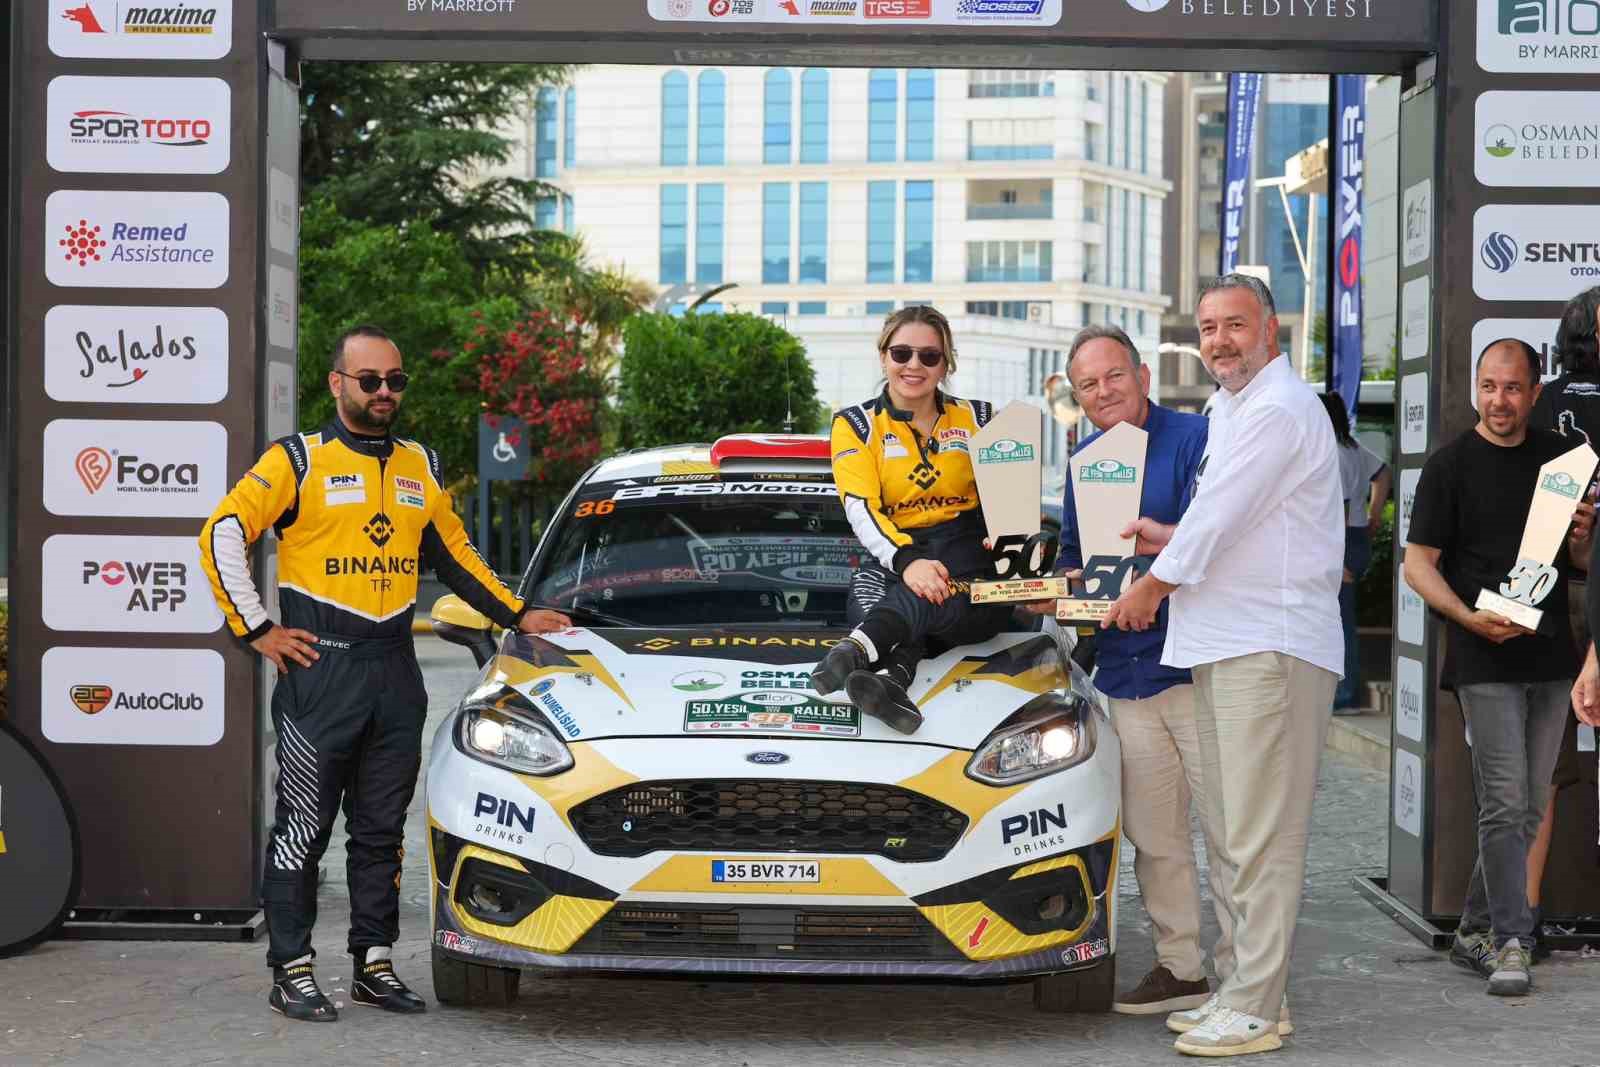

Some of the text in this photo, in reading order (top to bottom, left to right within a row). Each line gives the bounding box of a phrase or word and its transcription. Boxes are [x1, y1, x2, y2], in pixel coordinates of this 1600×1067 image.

[125, 3, 216, 25] maxima
[407, 0, 516, 13] BY MARRIOTT
[810, 0, 857, 11] maxima
[866, 1, 905, 16] TRS
[1519, 44, 1600, 58] BY MARRI
[1521, 124, 1598, 141] OSMAN
[1339, 104, 1364, 327] POWER
[111, 222, 188, 242] Remed
[110, 244, 214, 263] Assistance
[75, 325, 197, 378] Salados
[117, 456, 199, 485] Fora
[331, 474, 357, 485] PIN
[574, 500, 616, 518] 36
[83, 561, 187, 586] POWER
[370, 578, 392, 593] TR
[127, 588, 187, 612] APP
[741, 671, 812, 679] OSMA
[114, 692, 204, 711] AutoClub
[474, 791, 536, 834] PIN
[1000, 803, 1068, 845] PIN
[475, 823, 525, 845] DRINKS
[1013, 834, 1066, 857] DRINKS
[726, 864, 747, 879] 35
[750, 864, 785, 879] BVR
[787, 864, 817, 879] 714
